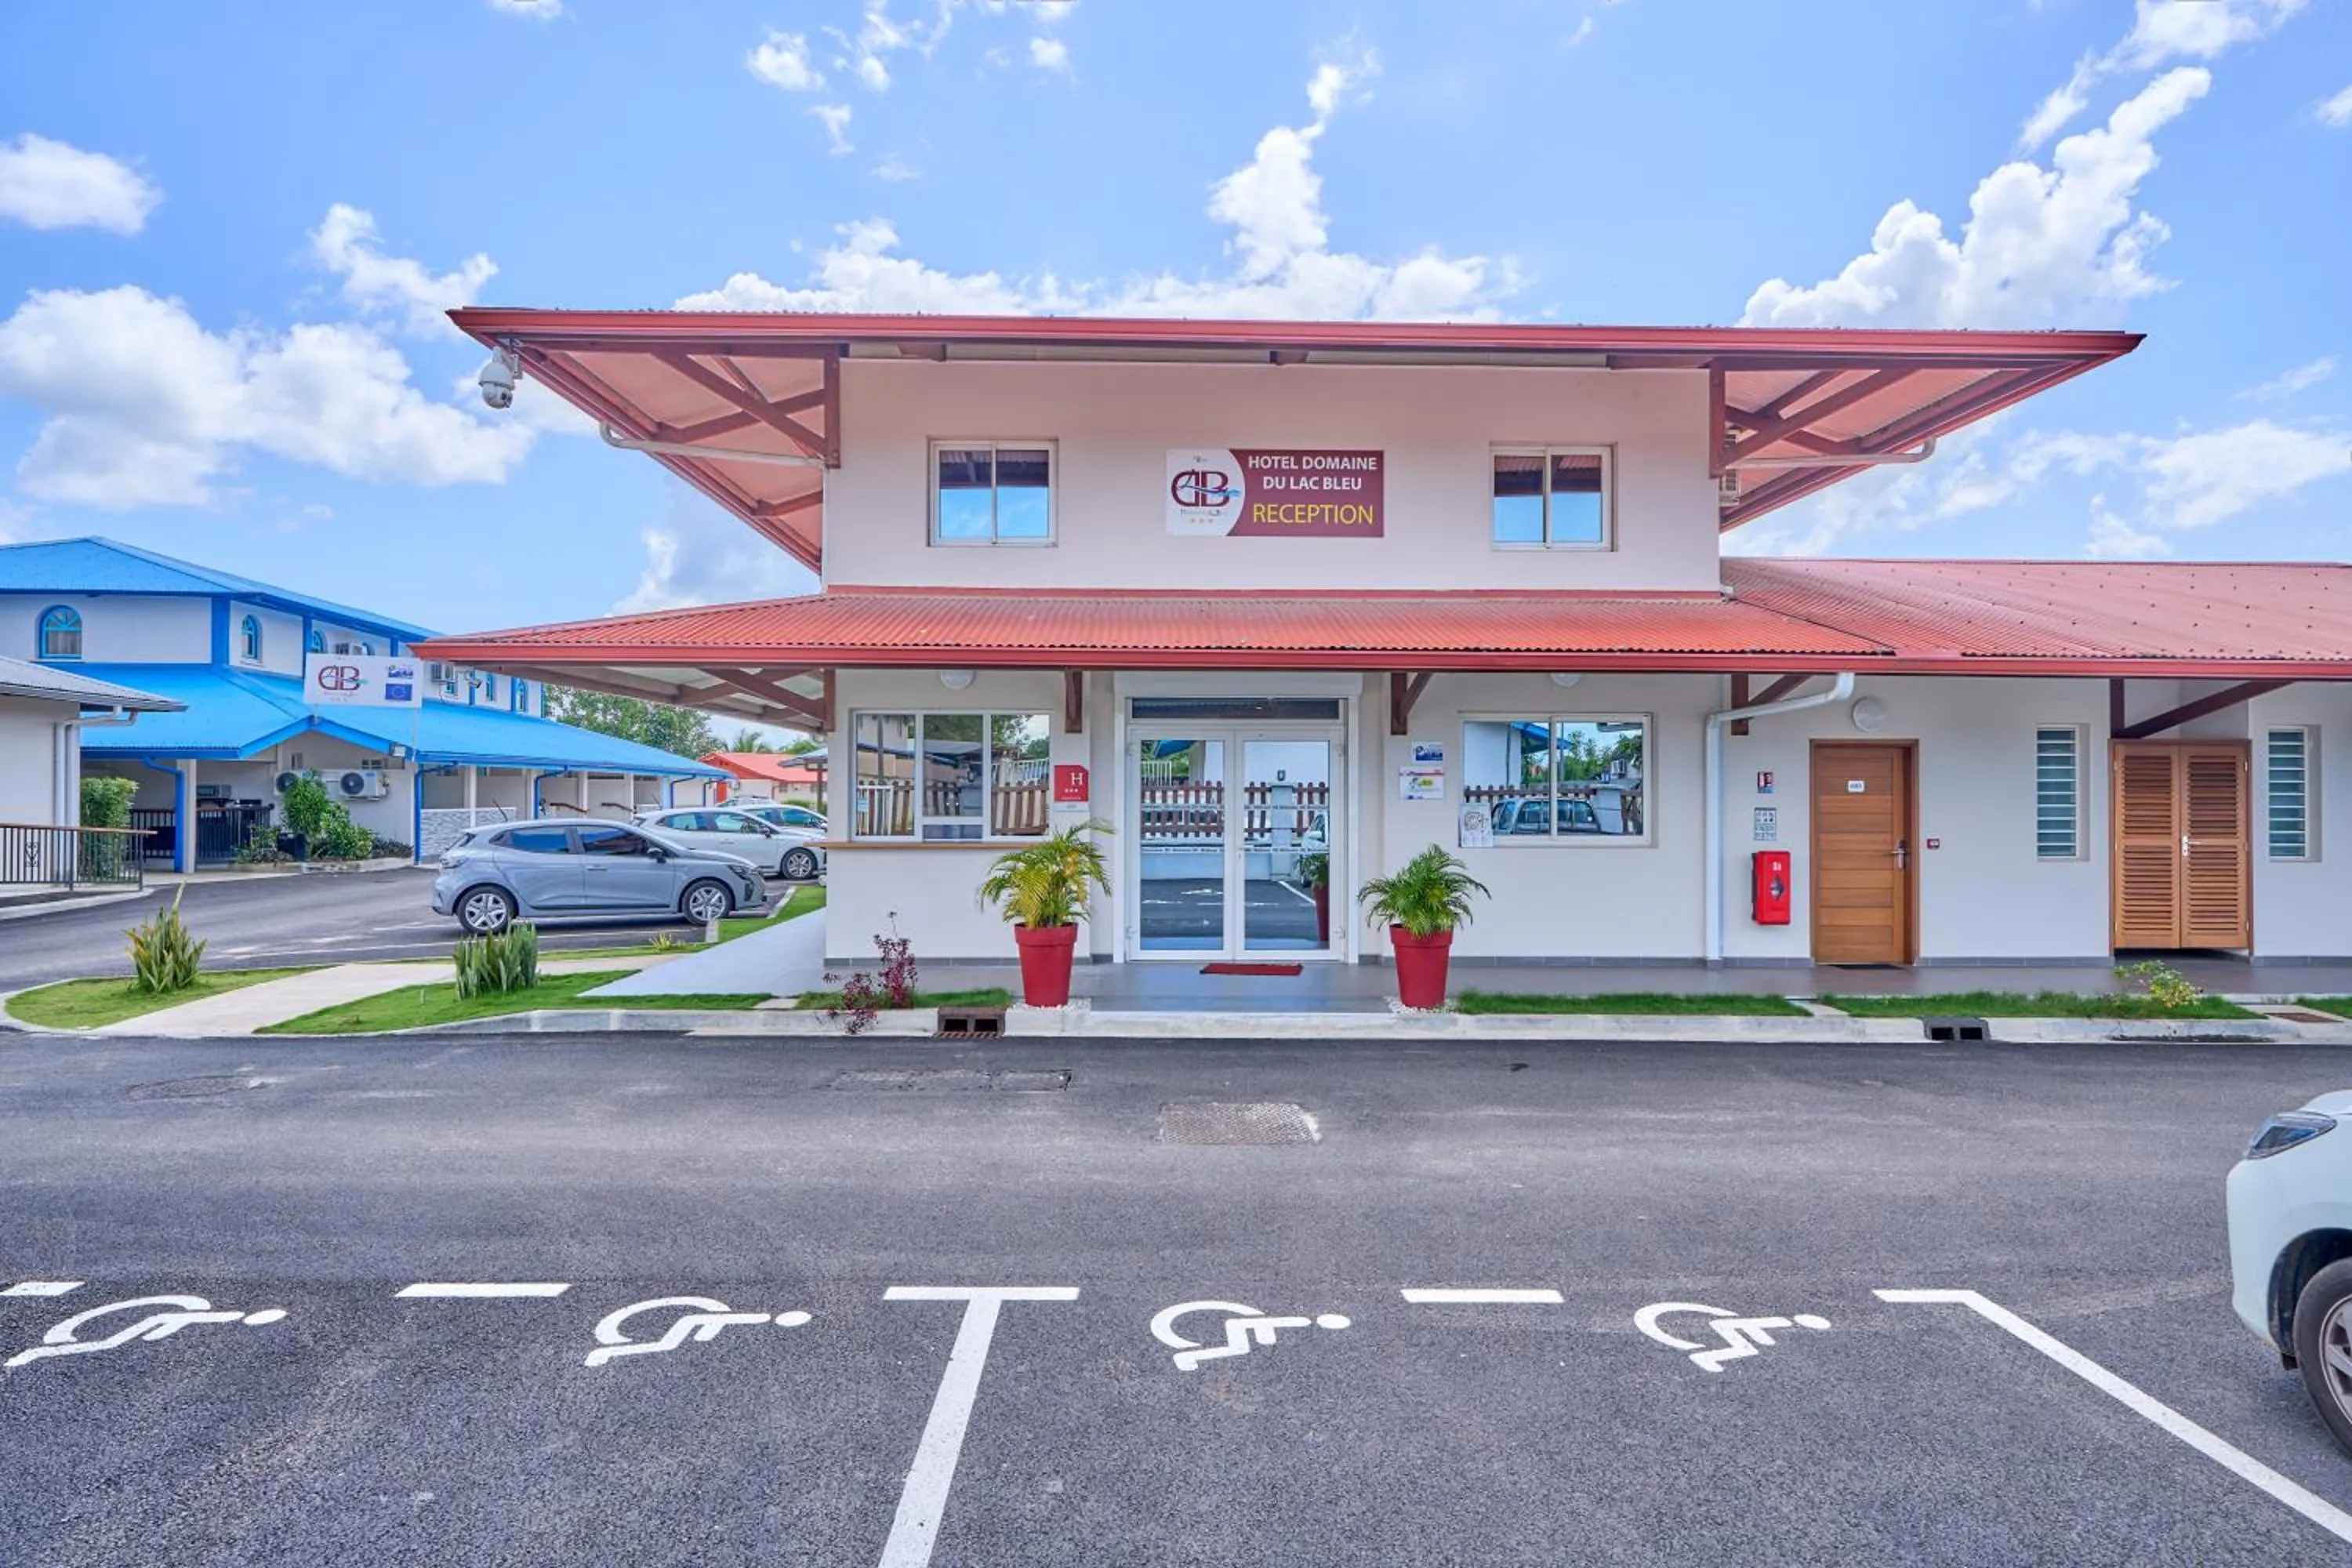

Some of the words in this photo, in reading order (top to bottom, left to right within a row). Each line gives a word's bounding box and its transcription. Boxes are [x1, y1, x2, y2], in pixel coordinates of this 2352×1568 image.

[1248, 456, 1299, 470] HOTEL
[1302, 456, 1377, 470] DOMAINE
[1263, 476, 1287, 490] DU
[1290, 476, 1319, 490] LAC
[1323, 477, 1363, 491] BLEU
[1253, 503, 1374, 524] RECEPTION
[1069, 771, 1083, 786] H
